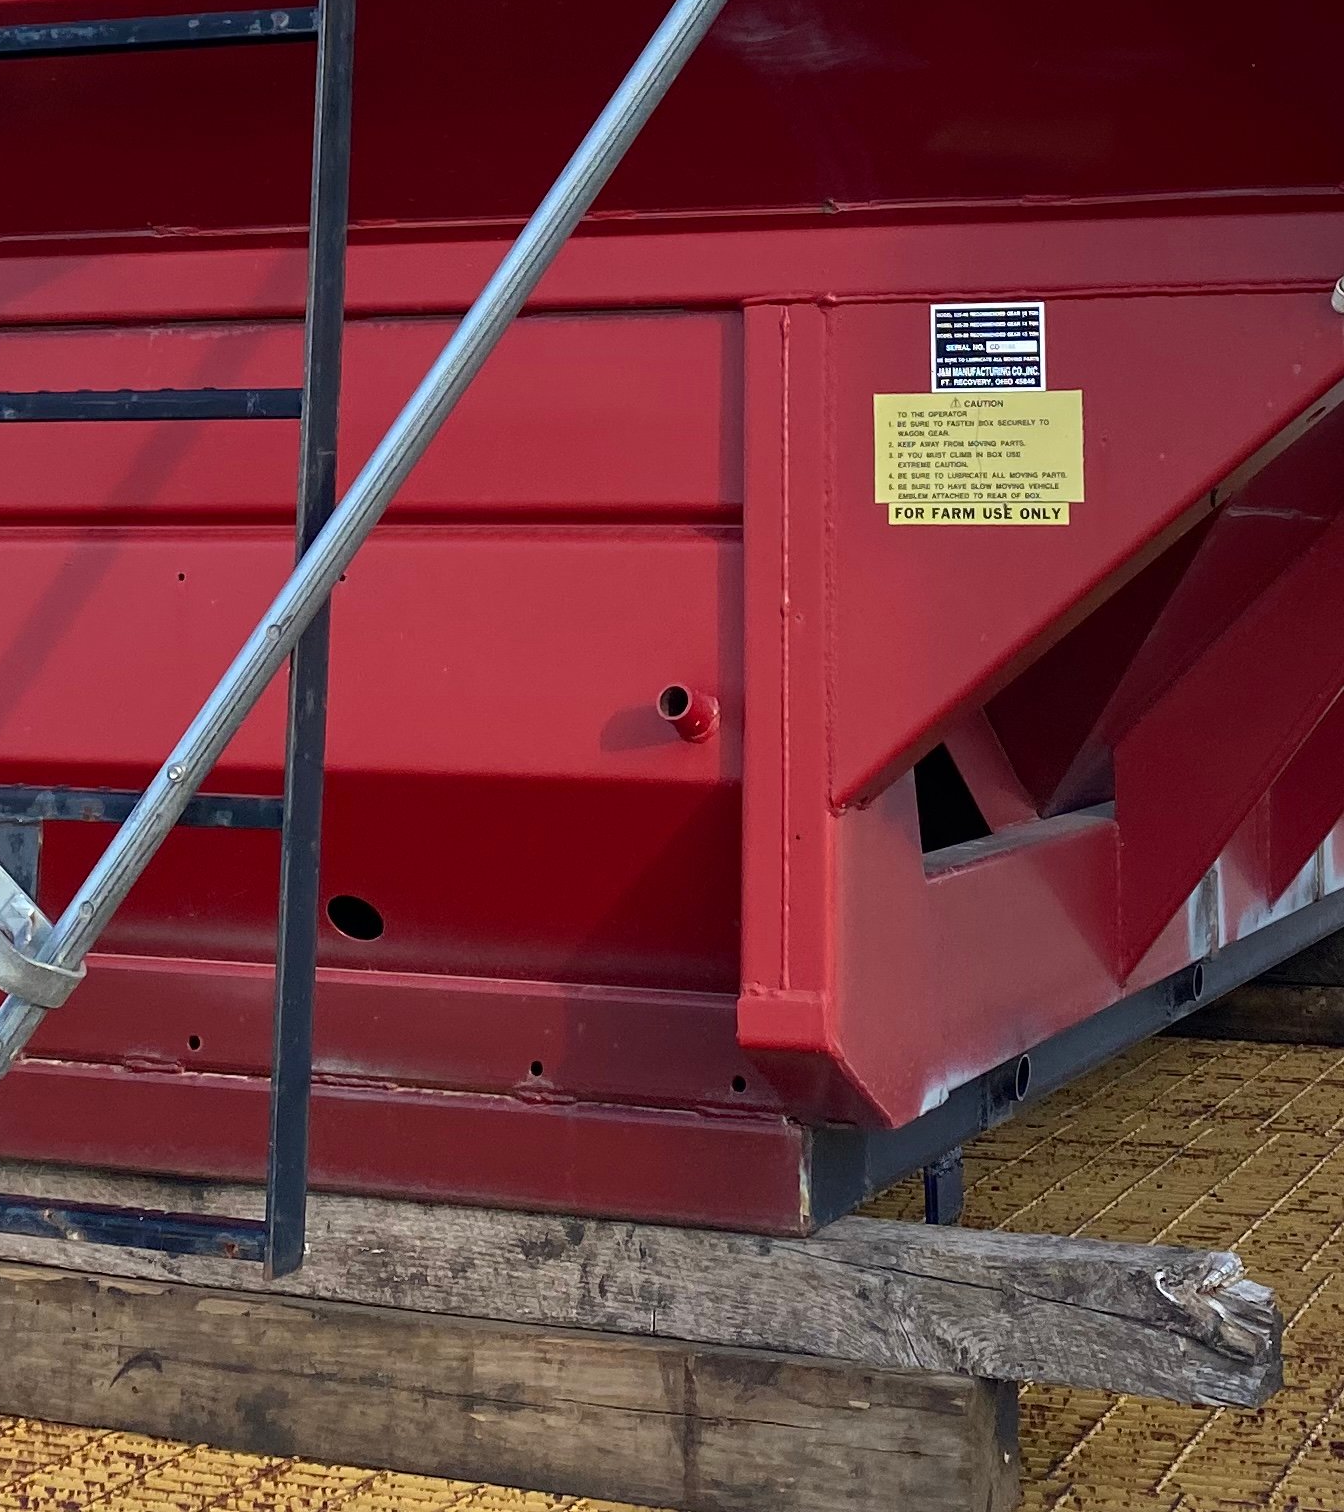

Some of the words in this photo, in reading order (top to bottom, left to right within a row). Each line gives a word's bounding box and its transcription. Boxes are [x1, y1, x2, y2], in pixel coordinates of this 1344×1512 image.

[952, 367, 1011, 377] MANUFACTURING
[953, 378, 994, 386] RECOVERY,
[964, 400, 1004, 408] CAUTION
[997, 419, 1036, 427] SECURELY
[897, 461, 931, 469] EXTREME
[1041, 471, 1067, 479] PARTS.
[895, 507, 925, 519] FOR
[931, 507, 975, 520] FARM
[982, 507, 1013, 520] USE
[1019, 507, 1061, 520] ONLY
